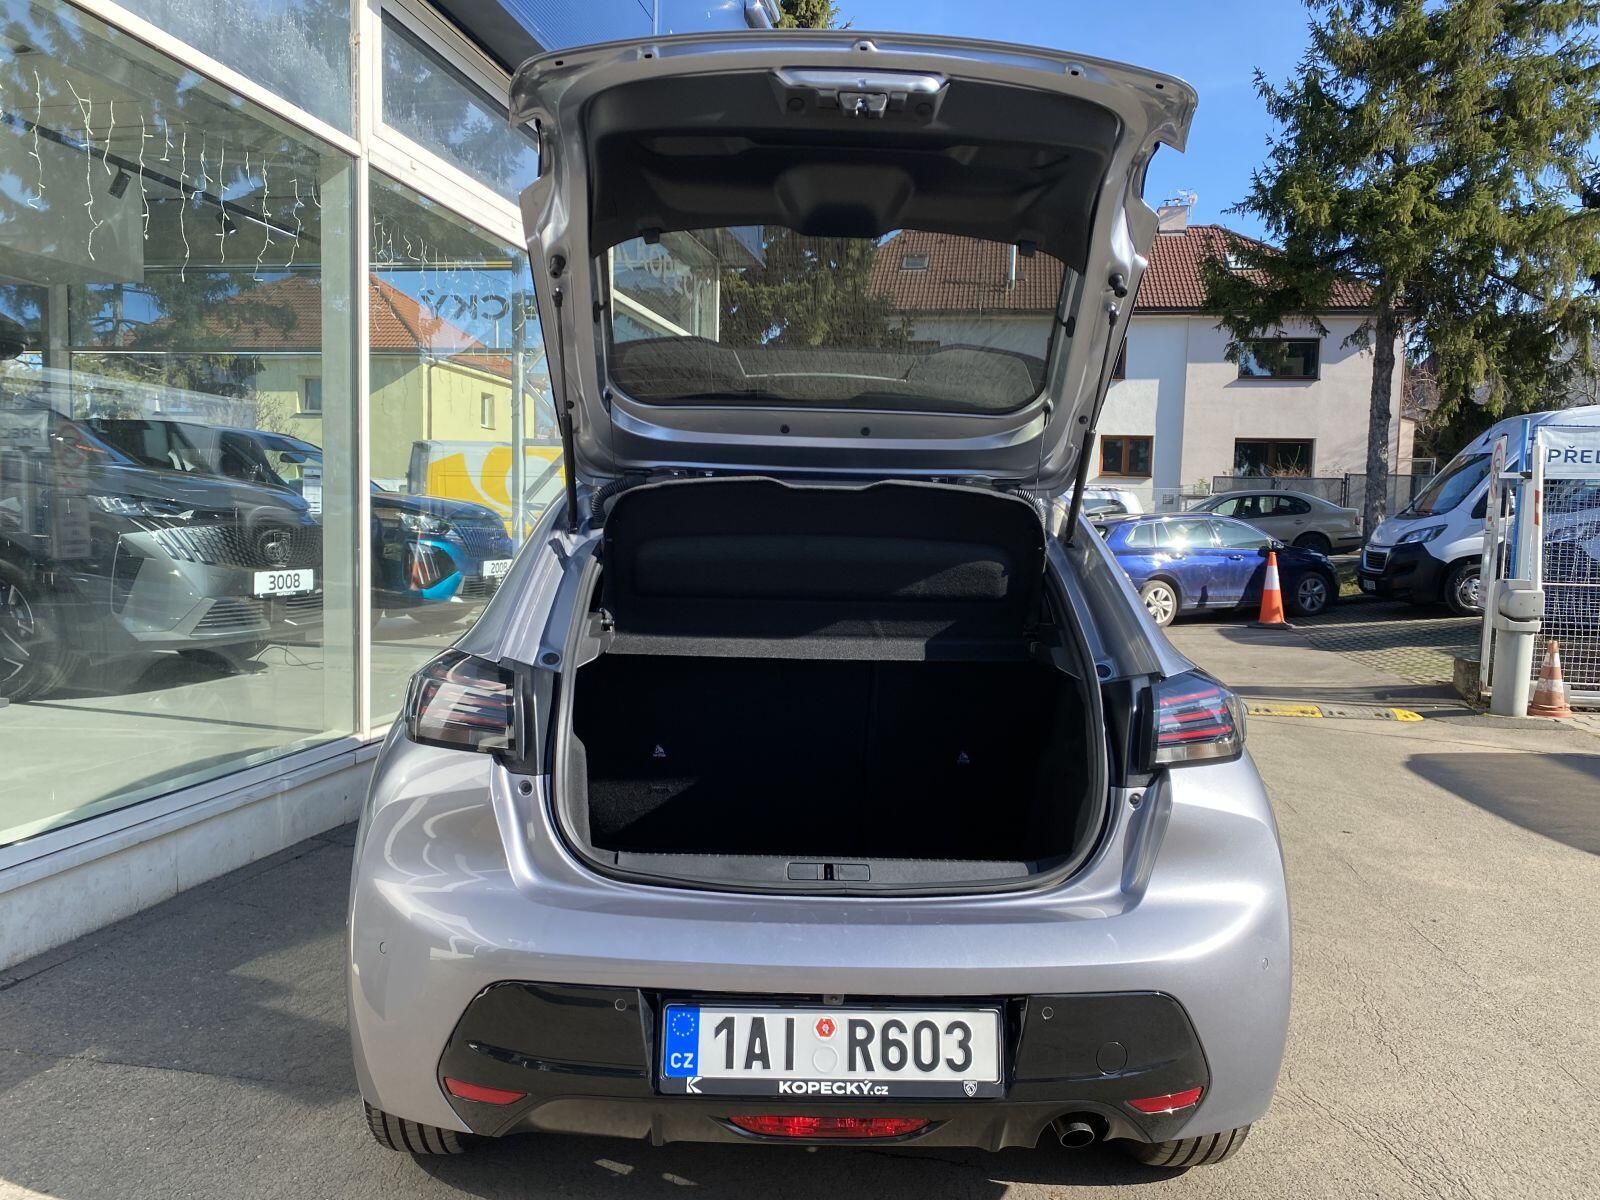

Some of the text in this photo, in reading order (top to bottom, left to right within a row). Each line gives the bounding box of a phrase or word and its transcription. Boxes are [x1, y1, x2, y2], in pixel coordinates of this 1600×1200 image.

[268, 573, 301, 590] 3008
[714, 1016, 973, 1073] 1AI R603
[670, 1052, 694, 1069] CZ
[778, 1079, 889, 1095] KOPECKÝ.cz
